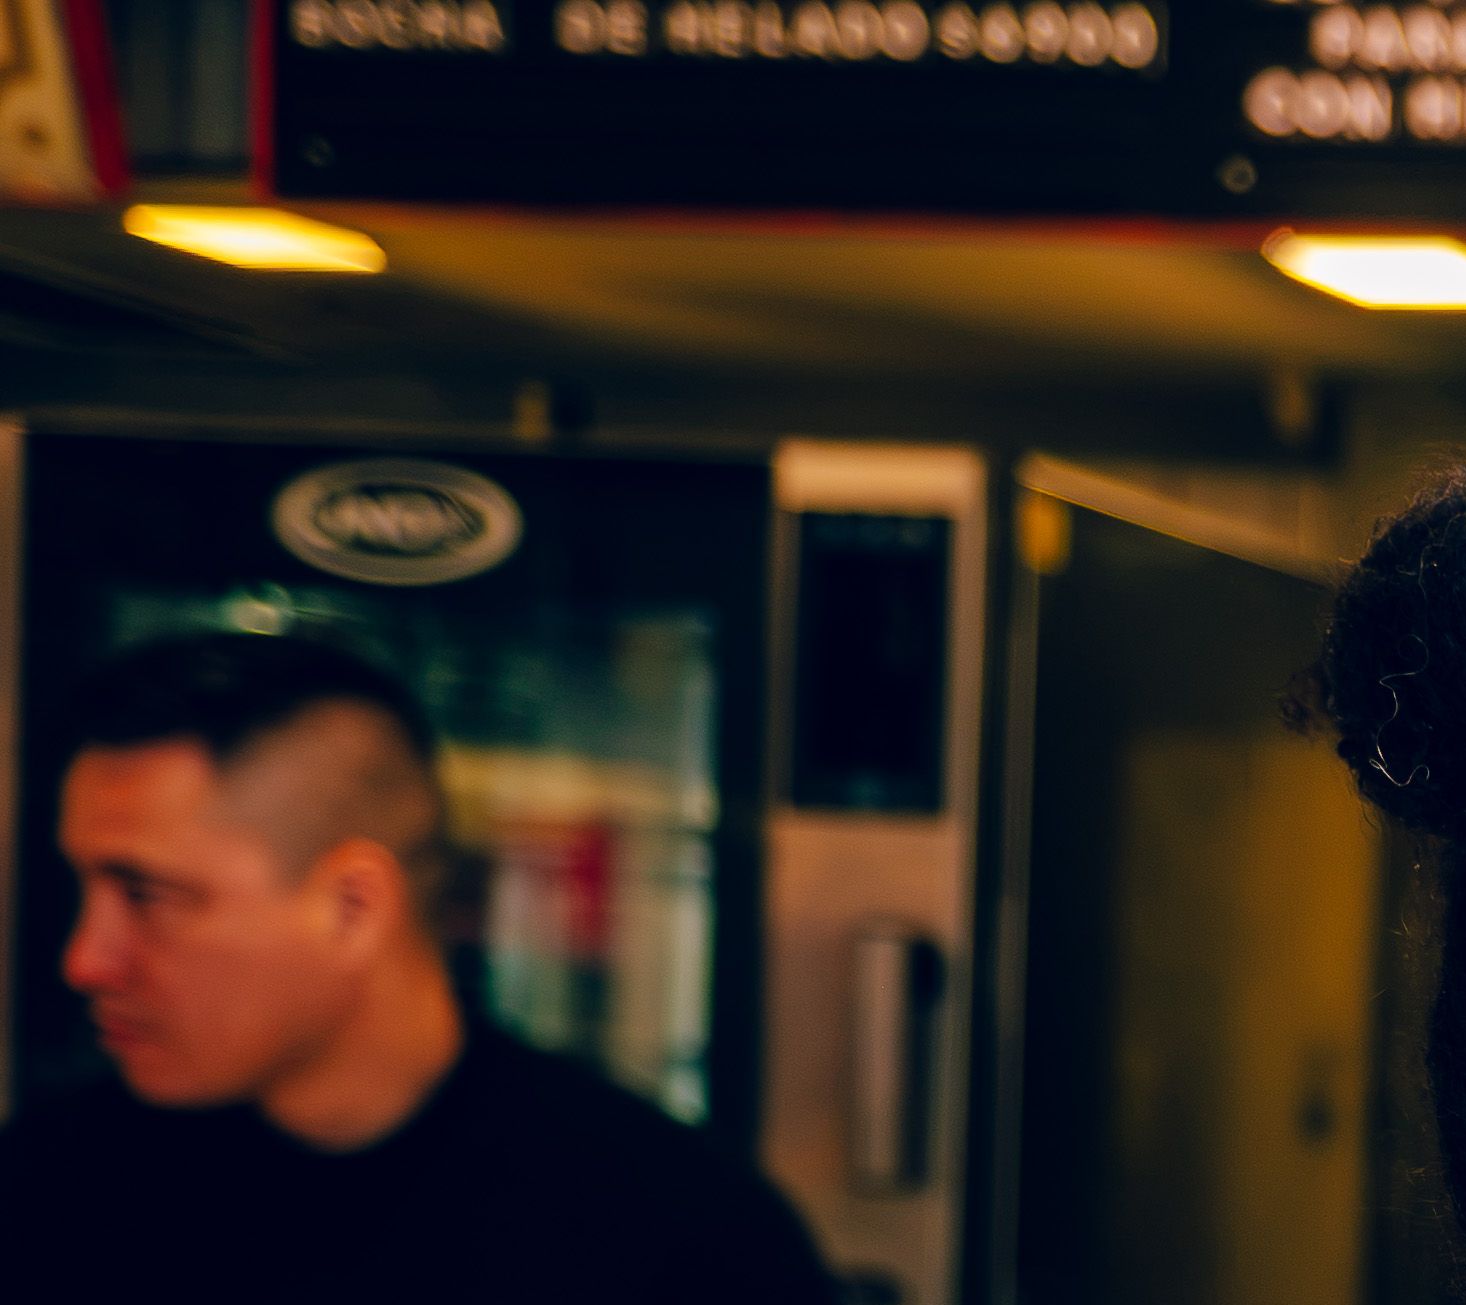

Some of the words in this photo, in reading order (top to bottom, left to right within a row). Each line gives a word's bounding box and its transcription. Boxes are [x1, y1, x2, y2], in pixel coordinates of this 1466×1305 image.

[555, 0, 647, 56] DE
[663, 0, 928, 62] HELADO
[1244, 67, 1392, 141] CON
